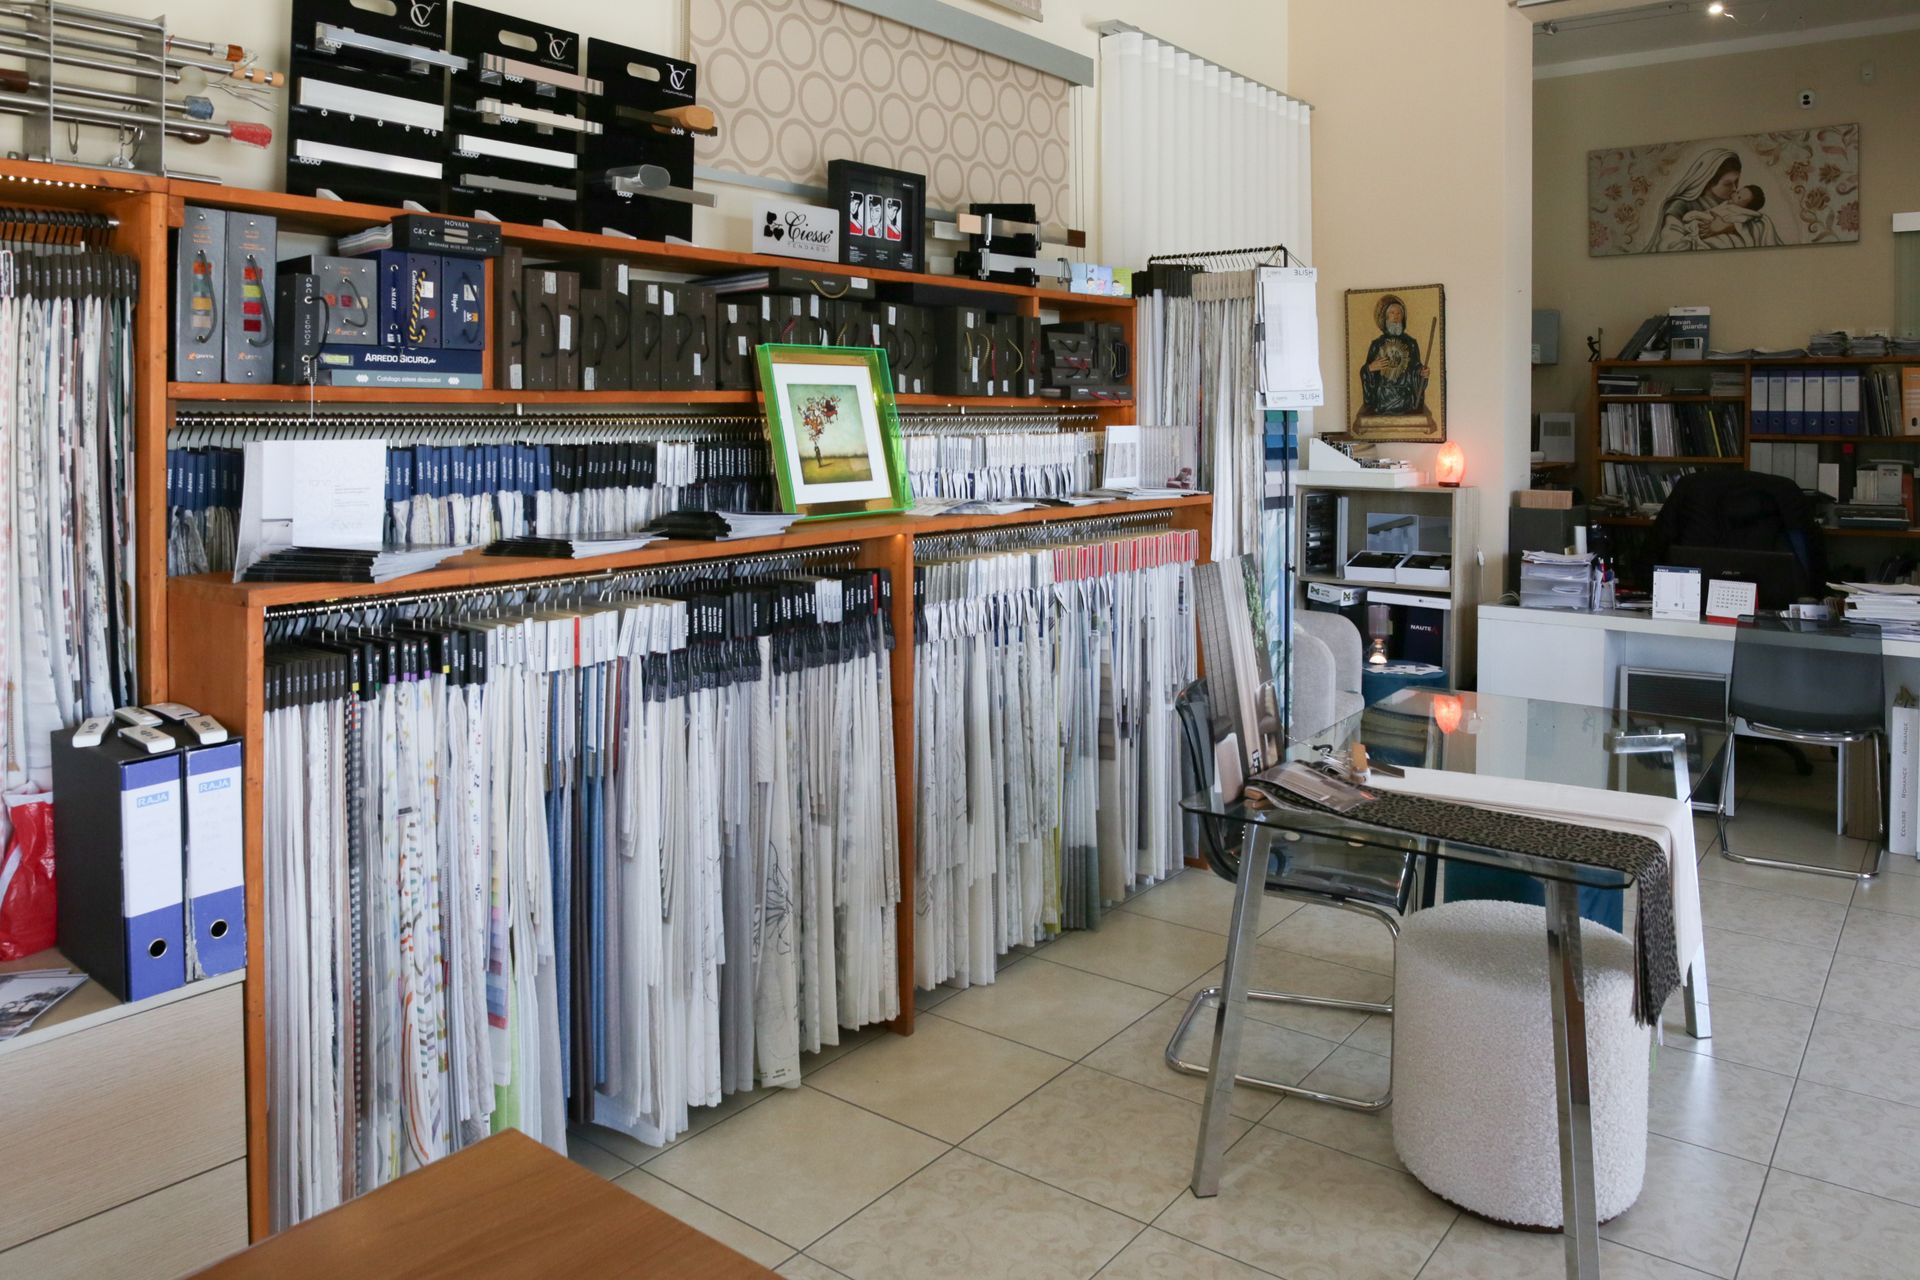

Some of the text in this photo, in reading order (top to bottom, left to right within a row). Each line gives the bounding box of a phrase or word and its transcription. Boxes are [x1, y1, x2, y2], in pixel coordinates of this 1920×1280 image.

[784, 210, 834, 245] Ciesse
[364, 353, 398, 363] ARREDO
[400, 354, 429, 364] SICURO
[199, 778, 230, 792] RAJA
[138, 791, 169, 808] RAJA
